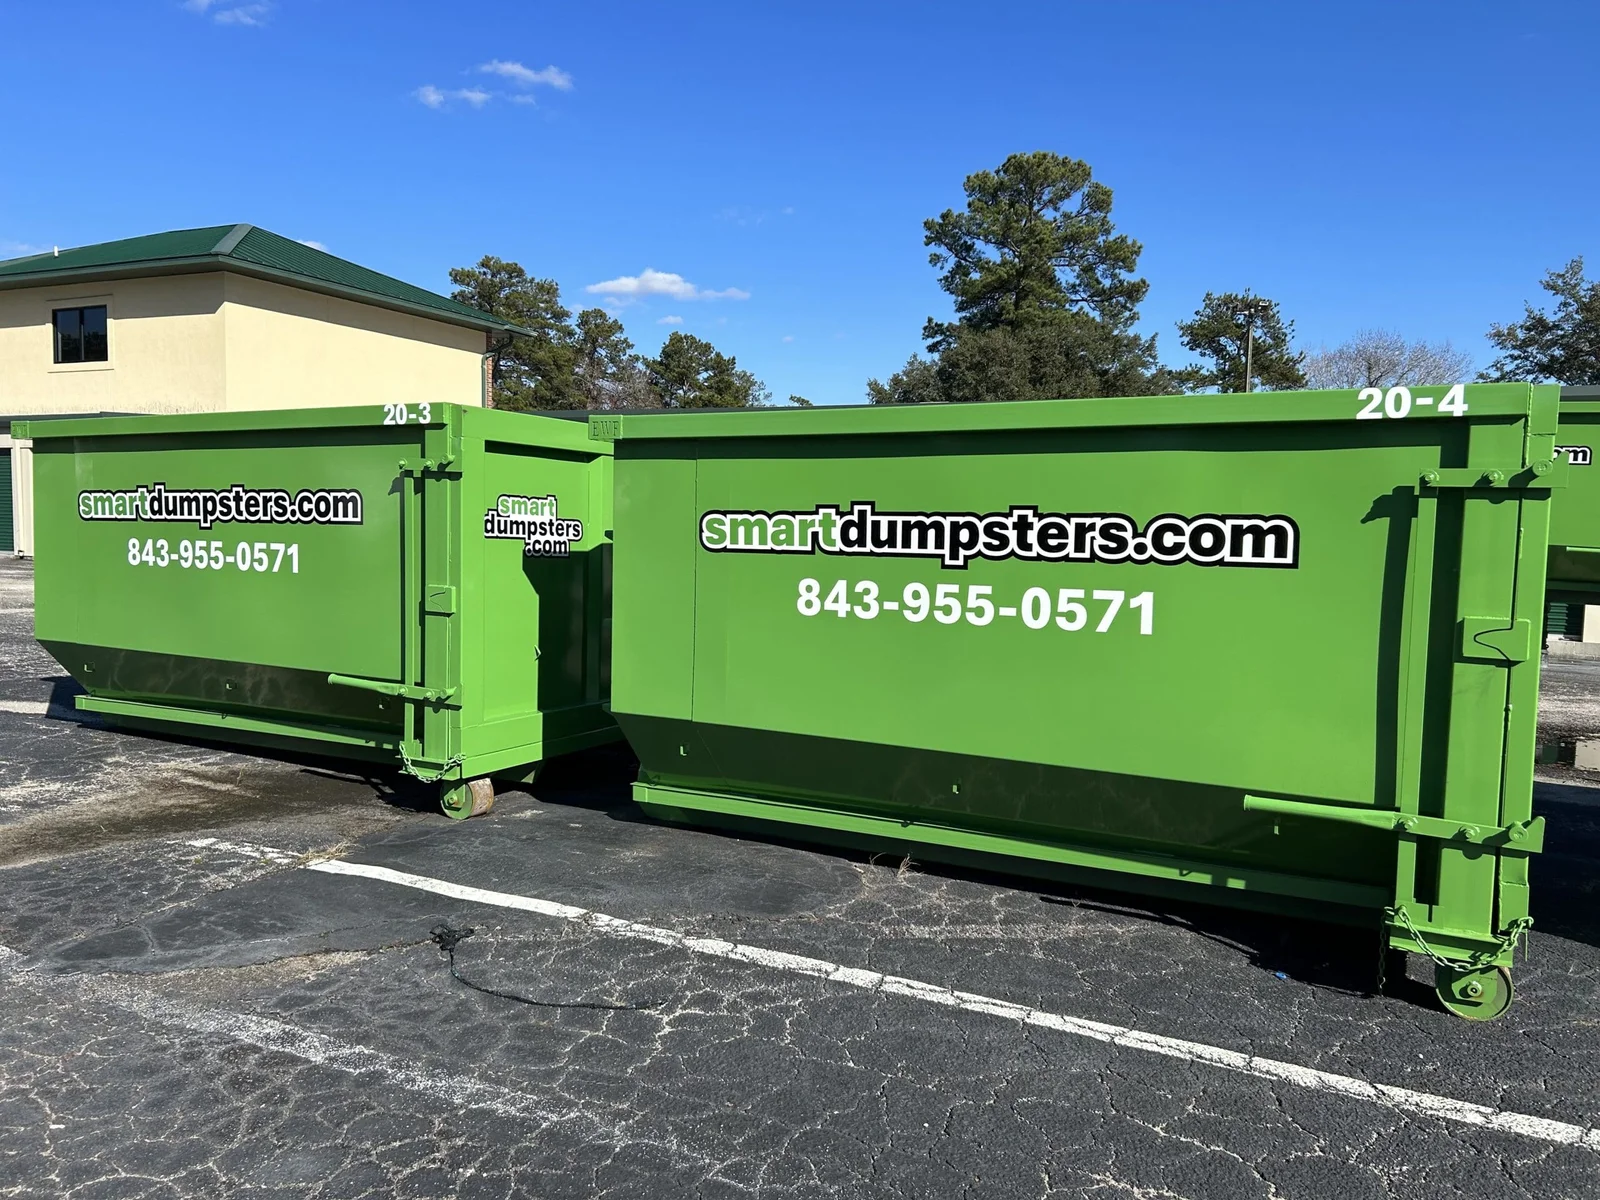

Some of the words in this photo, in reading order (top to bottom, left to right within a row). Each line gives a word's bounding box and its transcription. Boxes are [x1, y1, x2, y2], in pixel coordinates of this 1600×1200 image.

[383, 402, 431, 425] 20-3
[1356, 384, 1468, 420] 20-4
[592, 420, 619, 437] EWF
[79, 485, 362, 528] smartdumpsters.com
[498, 497, 555, 517] smart
[484, 512, 582, 539] dumpsters
[702, 504, 1295, 568] smartdumpsters.com
[127, 537, 299, 573] 843-955-0571
[525, 539, 569, 555] .com
[796, 578, 1155, 635] 843-955-0571
